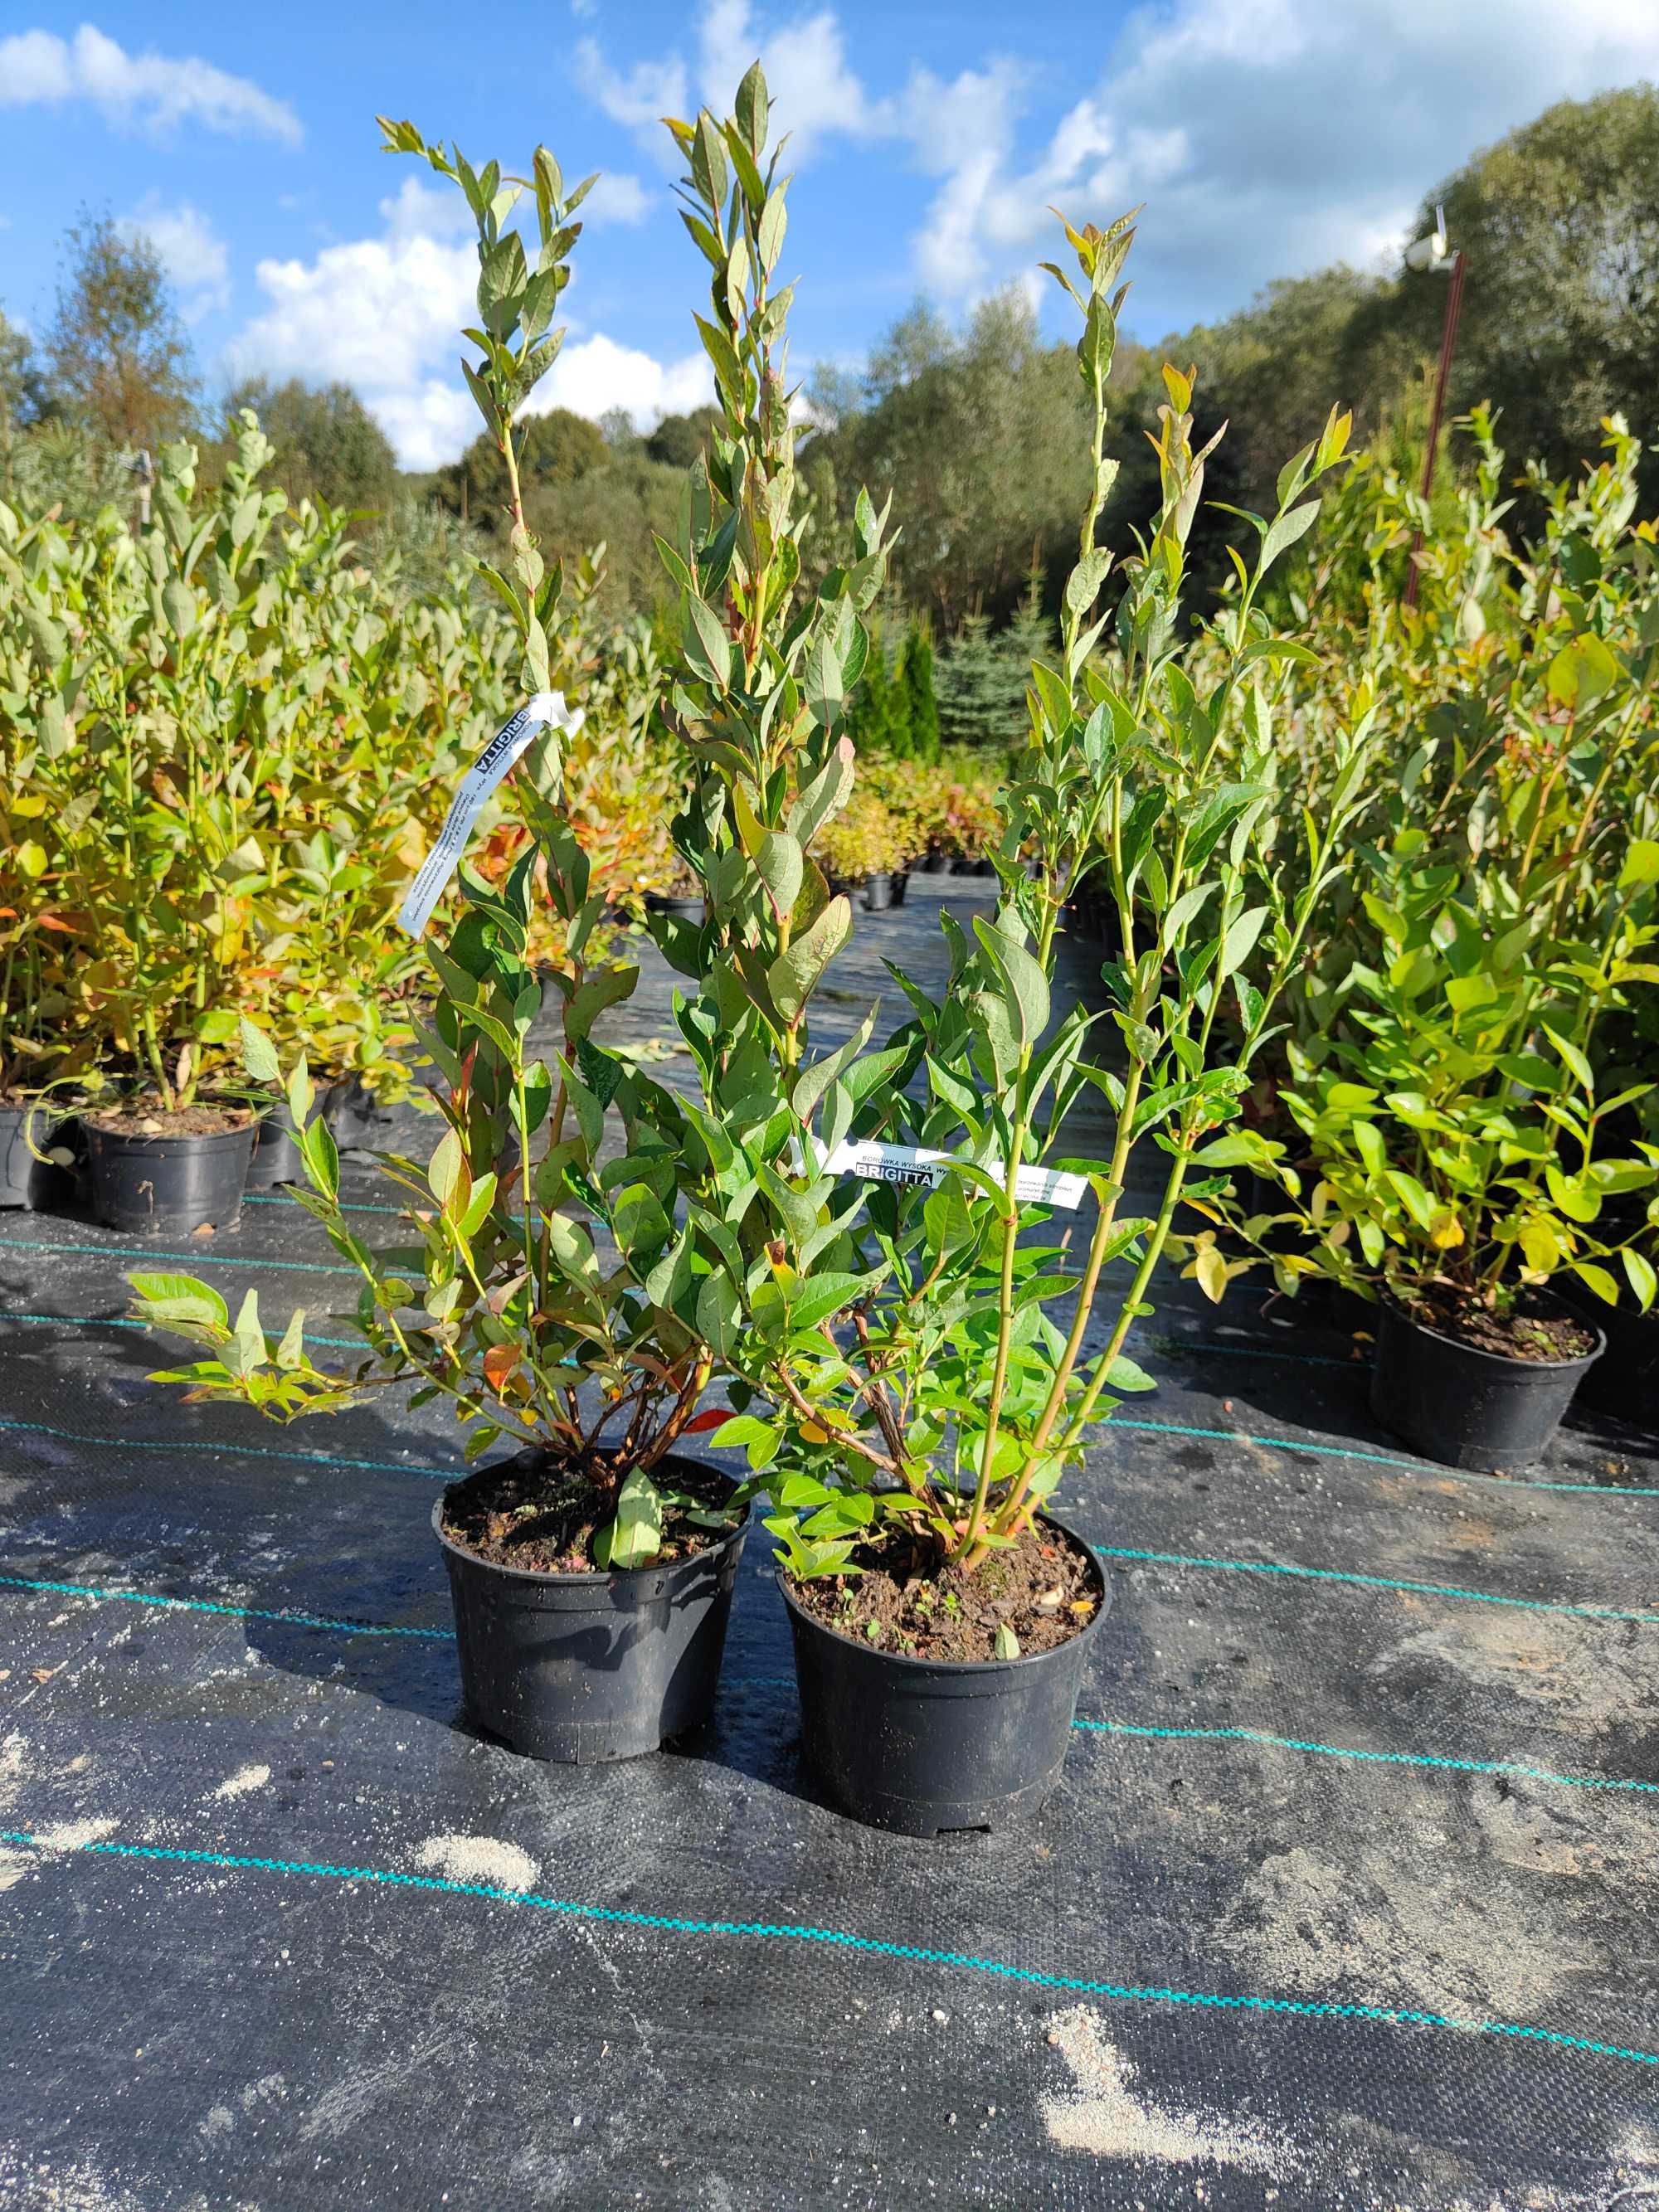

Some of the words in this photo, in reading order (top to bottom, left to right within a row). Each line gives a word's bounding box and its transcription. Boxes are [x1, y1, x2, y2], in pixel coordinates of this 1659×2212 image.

[475, 710, 530, 773] BRIGITTA
[857, 1164, 932, 1187] BRIGITTA
[901, 1161, 931, 1172] WYSOKA
